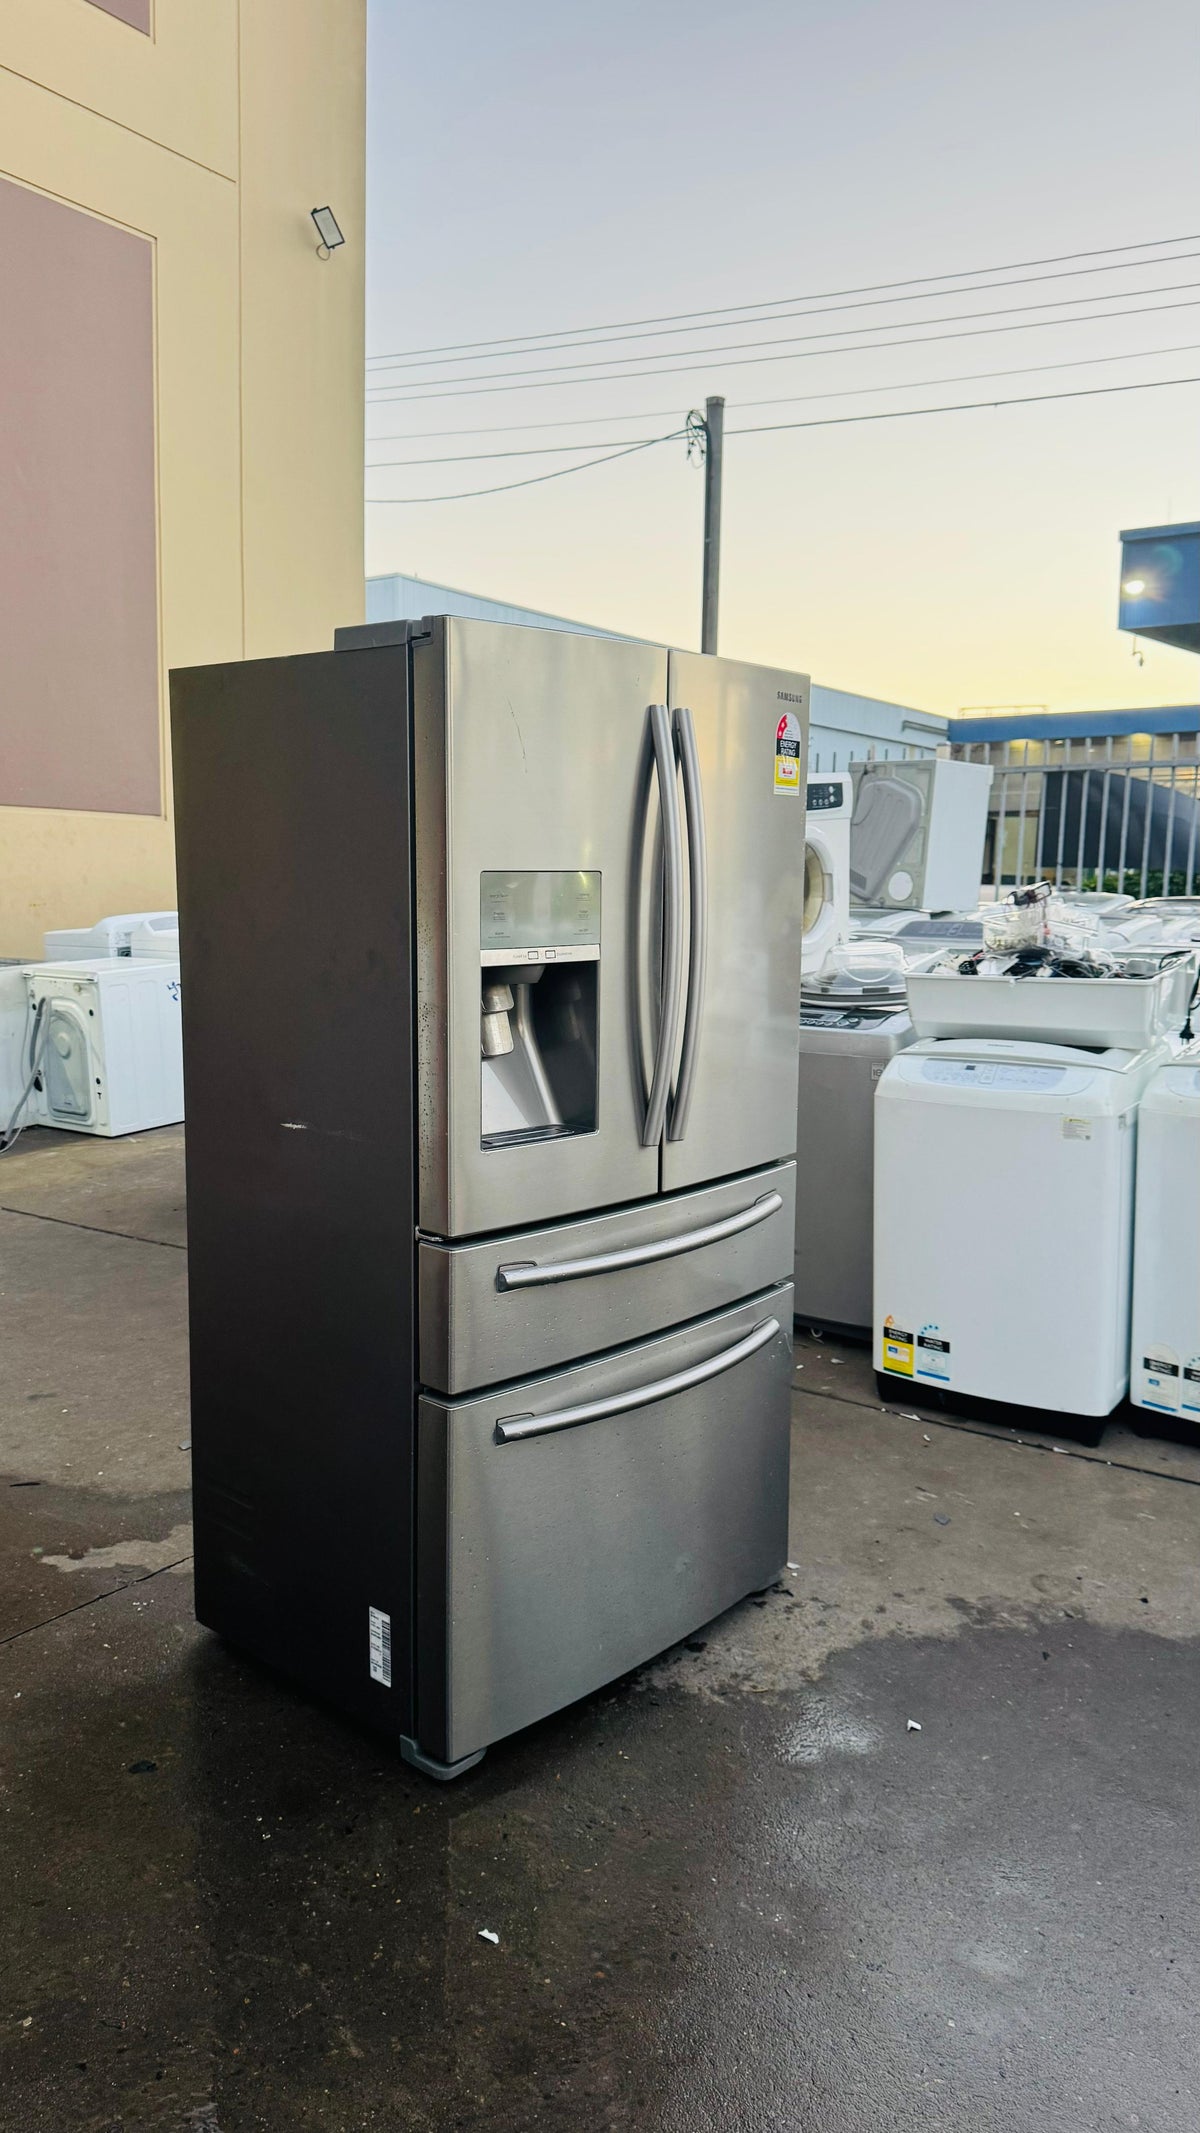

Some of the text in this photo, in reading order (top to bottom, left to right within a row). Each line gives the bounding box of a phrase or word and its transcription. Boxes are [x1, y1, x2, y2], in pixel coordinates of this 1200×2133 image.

[777, 691, 802, 703] SAMSUNG
[780, 740, 797, 749] ENERGY
[780, 747, 796, 756] RATING
